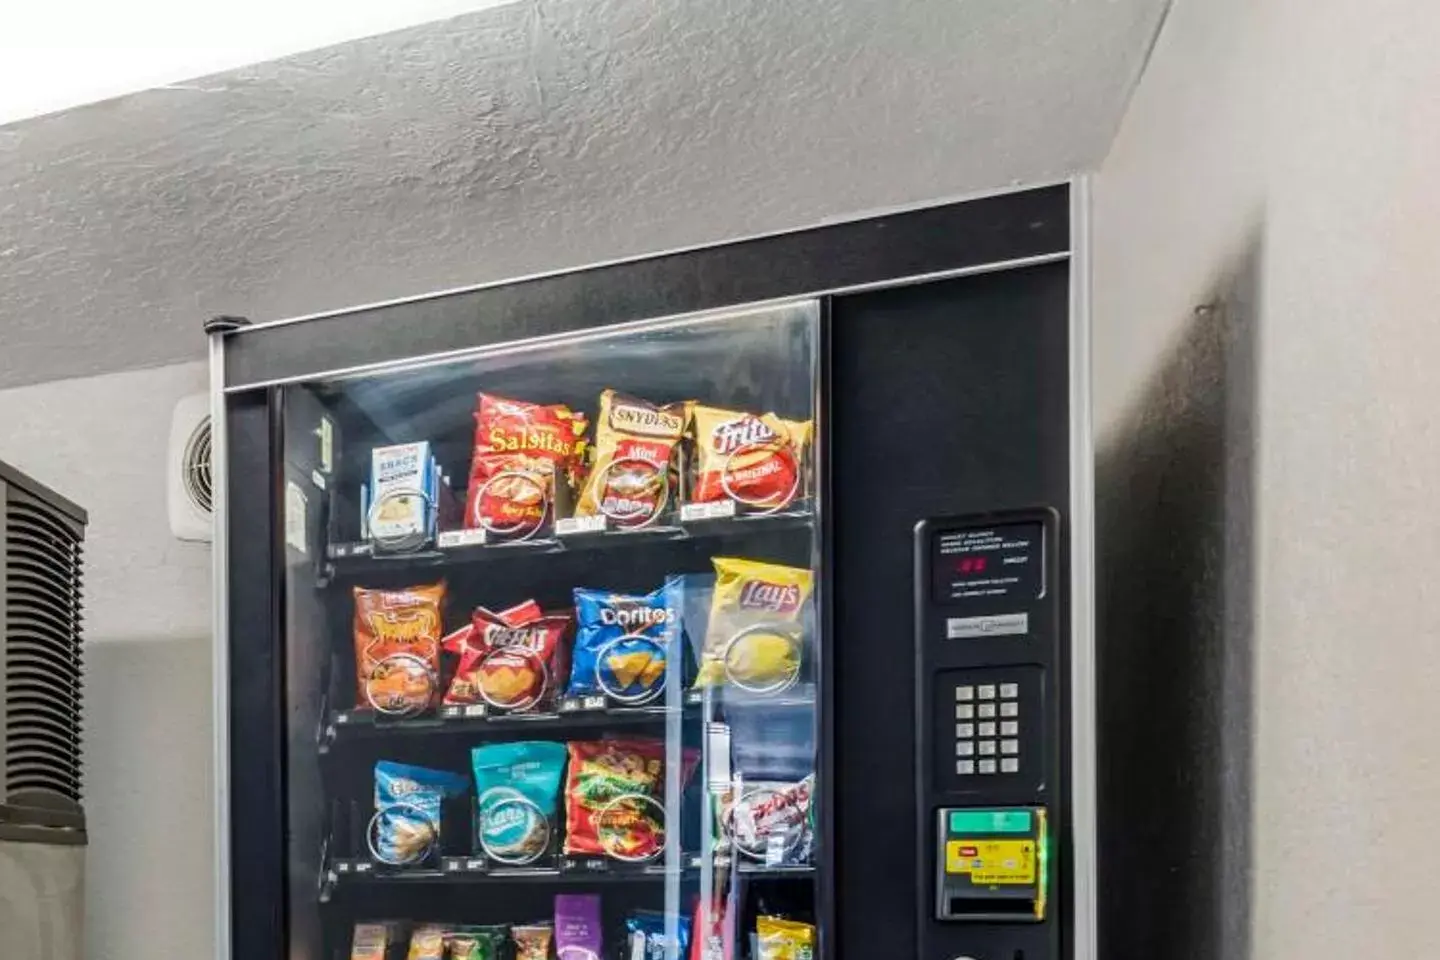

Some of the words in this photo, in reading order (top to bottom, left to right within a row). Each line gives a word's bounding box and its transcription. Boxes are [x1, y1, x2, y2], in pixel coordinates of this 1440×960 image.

[488, 427, 570, 456] Salsitas
[712, 417, 775, 454] Frito
[599, 606, 676, 626] Doritos
